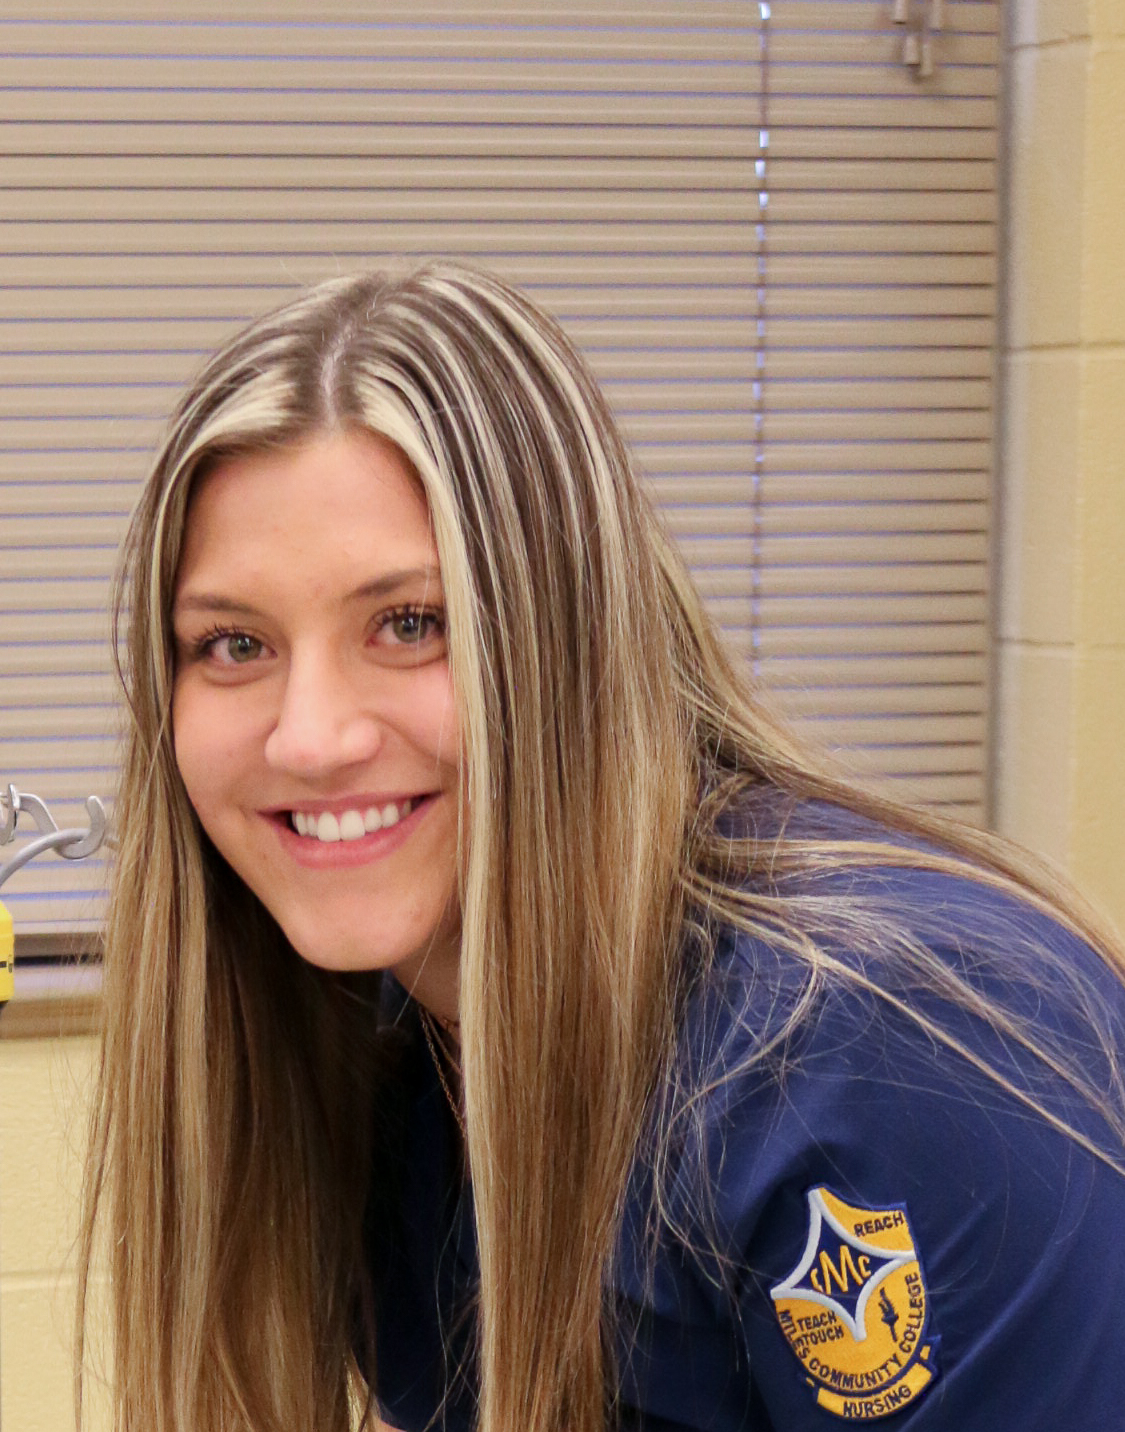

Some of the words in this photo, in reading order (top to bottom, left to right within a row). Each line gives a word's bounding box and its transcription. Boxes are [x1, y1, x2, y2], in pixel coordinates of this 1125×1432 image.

[853, 1211, 905, 1238] REACH
[778, 1309, 811, 1360] MILES
[809, 1352, 903, 1390] COMMUNITY
[898, 1271, 925, 1354] COLLEGE
[797, 1310, 838, 1333] TEACH
[800, 1325, 845, 1346] TOUCH
[842, 1384, 913, 1418] NURSING
